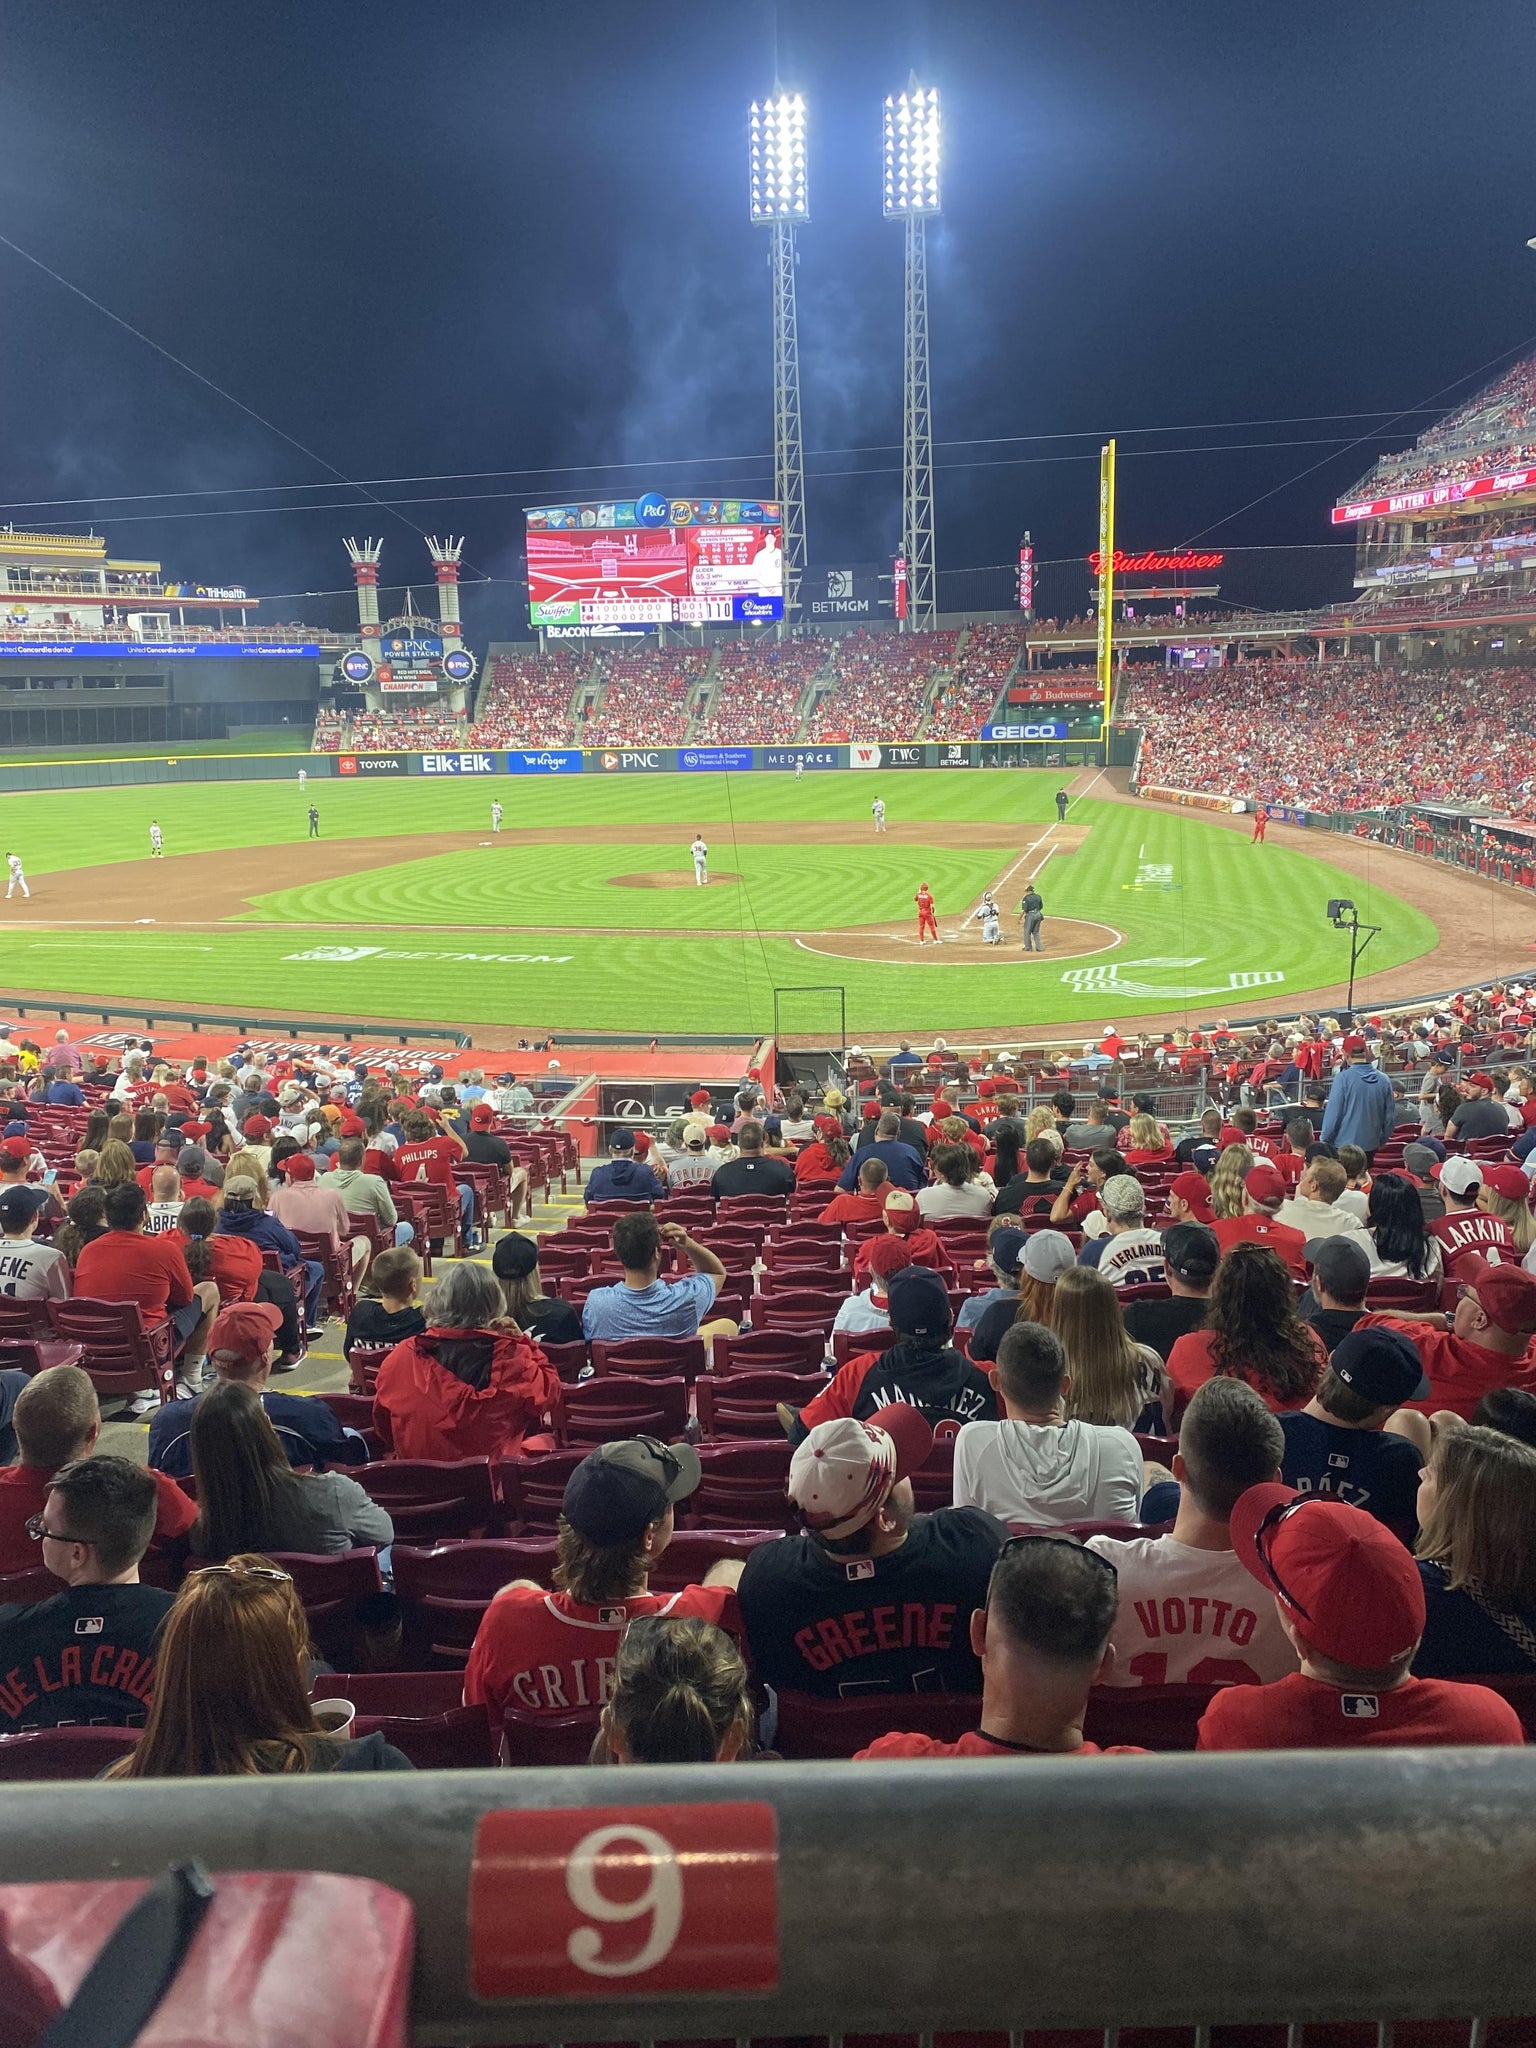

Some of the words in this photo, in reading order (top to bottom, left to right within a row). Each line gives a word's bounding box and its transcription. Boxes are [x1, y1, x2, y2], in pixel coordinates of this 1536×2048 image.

[1492, 473, 1529, 490] Energizer
[1389, 491, 1431, 511] BATTERY
[1433, 487, 1449, 503] UP!
[643, 504, 666, 517] P&G
[672, 507, 690, 521] Tide
[1345, 503, 1373, 519] Energizer
[1088, 550, 1224, 575] Budweiser
[206, 587, 246, 599] TriHealth
[536, 605, 573, 619] Swiffer
[812, 600, 869, 613] BETMGM
[546, 625, 590, 638] BEACON
[17, 646, 52, 654] Concordia
[52, 646, 73, 654] dental
[404, 640, 432, 651] PNC
[1045, 690, 1094, 700] Budweiser
[991, 725, 1056, 739] GEICO
[621, 752, 660, 768] PNC
[768, 753, 832, 764] MEDPACE
[888, 748, 920, 761] TWC
[359, 760, 399, 769] TOYOTA
[537, 753, 568, 771] Kroger
[374, 951, 575, 963] BETMGM
[360, 1047, 462, 1061] LEAGUE
[975, 1105, 1001, 1116] LARKI
[401, 1149, 438, 1165] PHILLIPS
[415, 1163, 430, 1183] 4
[1434, 1218, 1505, 1254] LARKIN
[1133, 1597, 1258, 1646] VOTTO
[794, 1602, 957, 1672] GREENE
[34, 1645, 82, 1692] LA
[567, 1823, 684, 1977] 9
